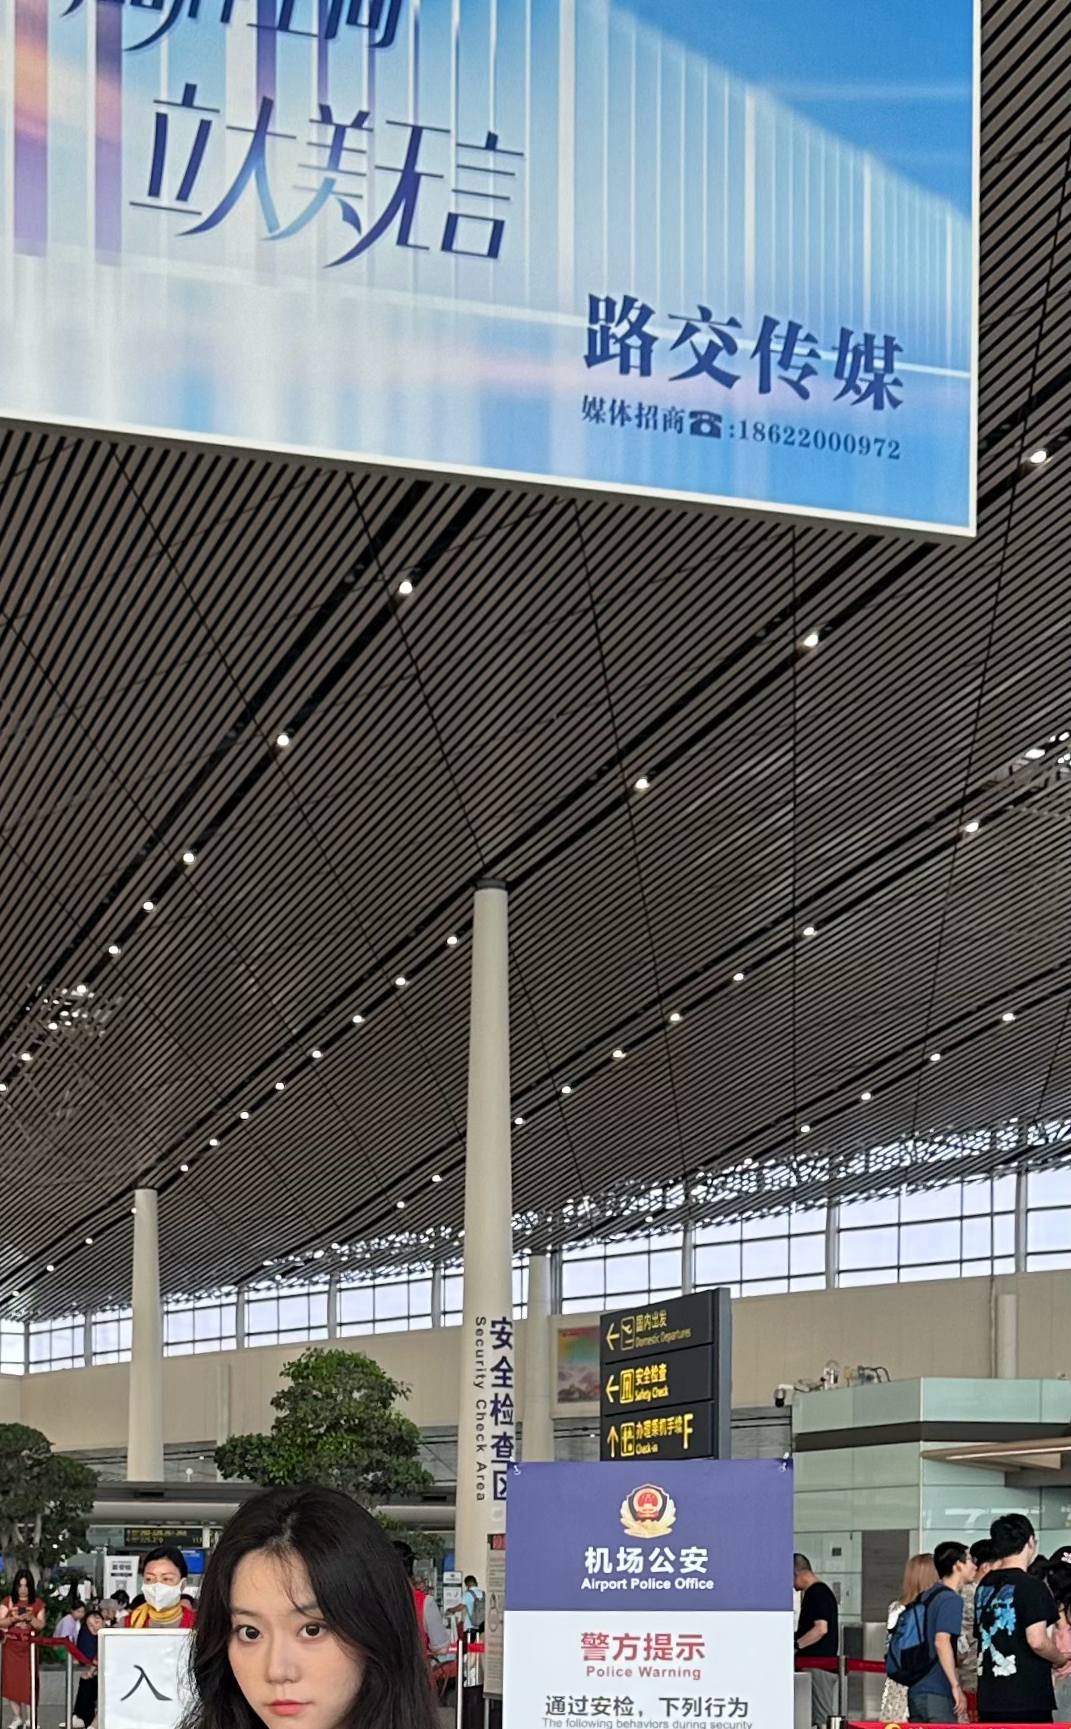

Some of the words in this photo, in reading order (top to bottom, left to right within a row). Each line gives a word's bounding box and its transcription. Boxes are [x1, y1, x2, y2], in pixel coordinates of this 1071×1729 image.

[129, 82, 525, 269] 立大美无言
[583, 293, 905, 412] 路交传媒
[581, 394, 685, 435] 媒体招商
[473, 1316, 487, 1390] Security
[635, 1363, 668, 1386] 安全检查
[652, 1385, 669, 1398] Check
[475, 1399, 487, 1453] Check
[683, 1412, 694, 1450] F
[476, 1461, 488, 1501] Area
[584, 1546, 709, 1575] 机场公安
[581, 1578, 627, 1592] Airport
[630, 1577, 671, 1590] Police
[675, 1577, 714, 1590] Office
[580, 1632, 706, 1662] 警方提示
[120, 1664, 174, 1702] 入
[586, 1665, 633, 1678] Police
[638, 1665, 702, 1681] Warning
[542, 1718, 563, 1728] The
[565, 1718, 613, 1729] following
[616, 1719, 669, 1729] behaviors
[544, 1695, 749, 1718] 通过安检，下列行为
